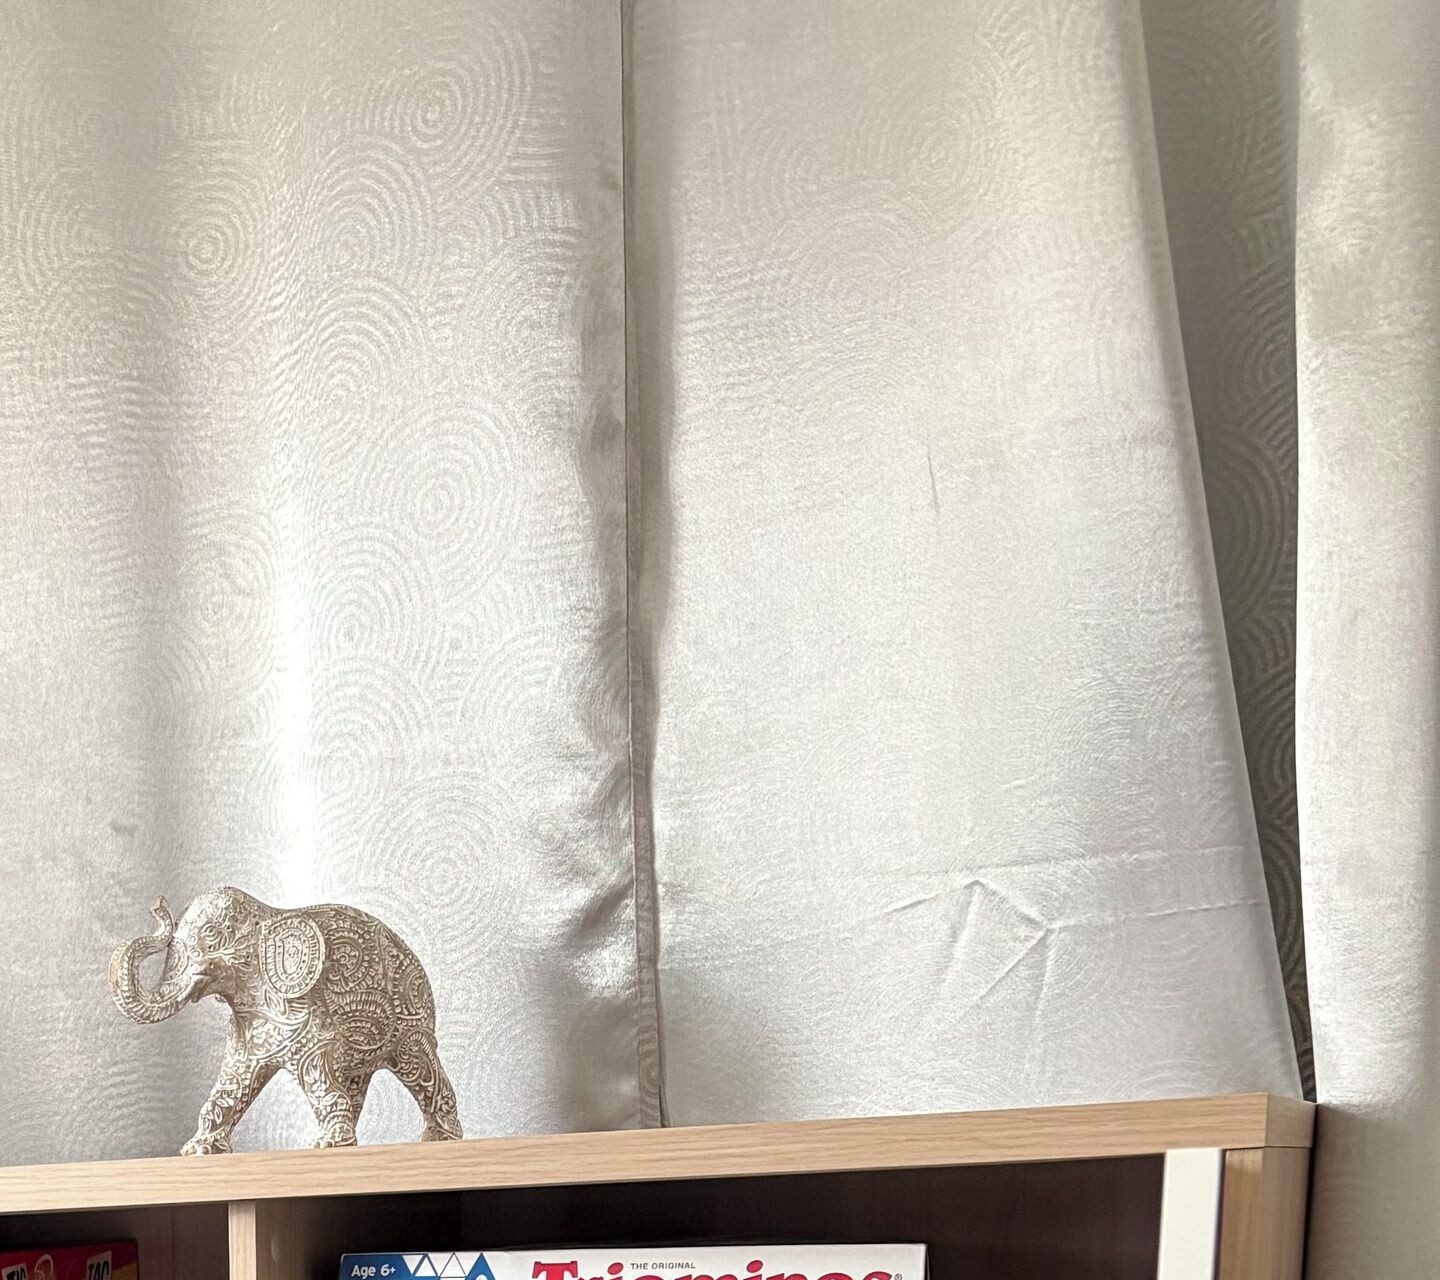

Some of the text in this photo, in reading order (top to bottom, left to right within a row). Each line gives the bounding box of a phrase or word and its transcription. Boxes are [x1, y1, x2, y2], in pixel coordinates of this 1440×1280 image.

[630, 1261, 696, 1270] THE ORIGINAL
[351, 1264, 396, 1280] Age 6+
